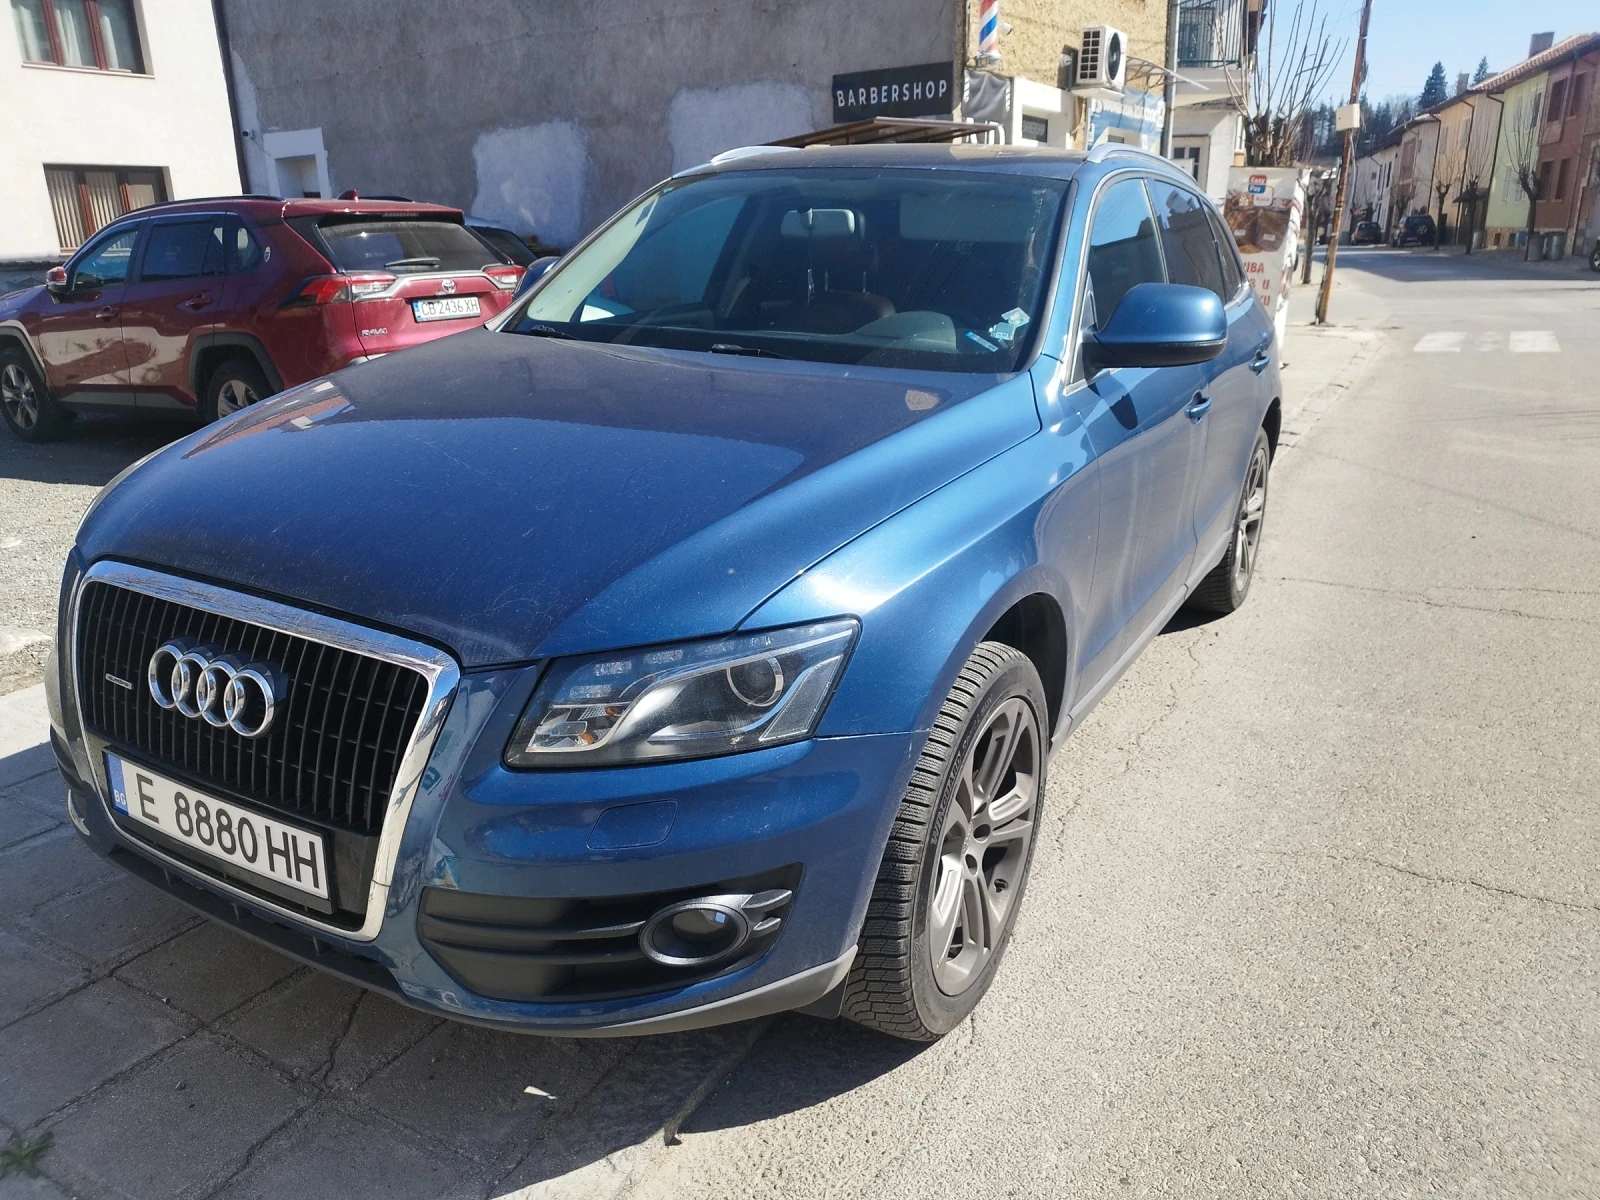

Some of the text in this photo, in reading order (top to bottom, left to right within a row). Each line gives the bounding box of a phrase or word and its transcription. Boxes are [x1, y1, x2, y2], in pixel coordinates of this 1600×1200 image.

[837, 80, 947, 107] BARBERSHOP
[1250, 176, 1266, 184] Easy
[1250, 185, 1262, 193] Pay
[421, 299, 479, 316] CB 2436 XH
[114, 789, 126, 805] BG
[930, 754, 962, 845] WINGUARD
[136, 772, 320, 890] E 8880 HH
